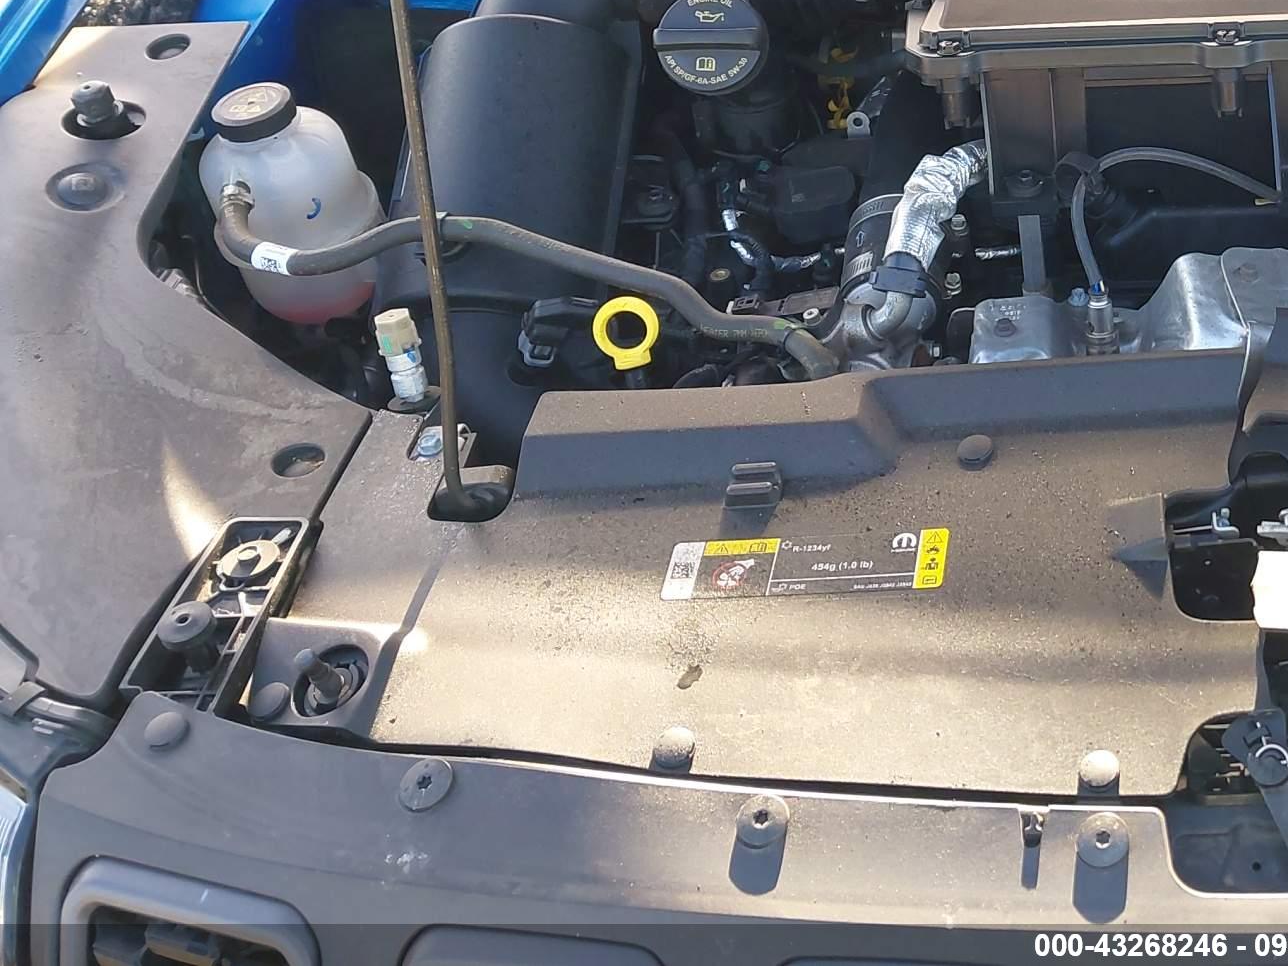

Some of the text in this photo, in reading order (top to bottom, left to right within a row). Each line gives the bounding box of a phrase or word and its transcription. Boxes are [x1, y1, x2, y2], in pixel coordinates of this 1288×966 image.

[664, 54, 676, 68] API
[728, 57, 749, 78] 5W-30
[792, 543, 831, 553] R-1234yf
[811, 562, 836, 572] 454g
[859, 560, 874, 569] lb)
